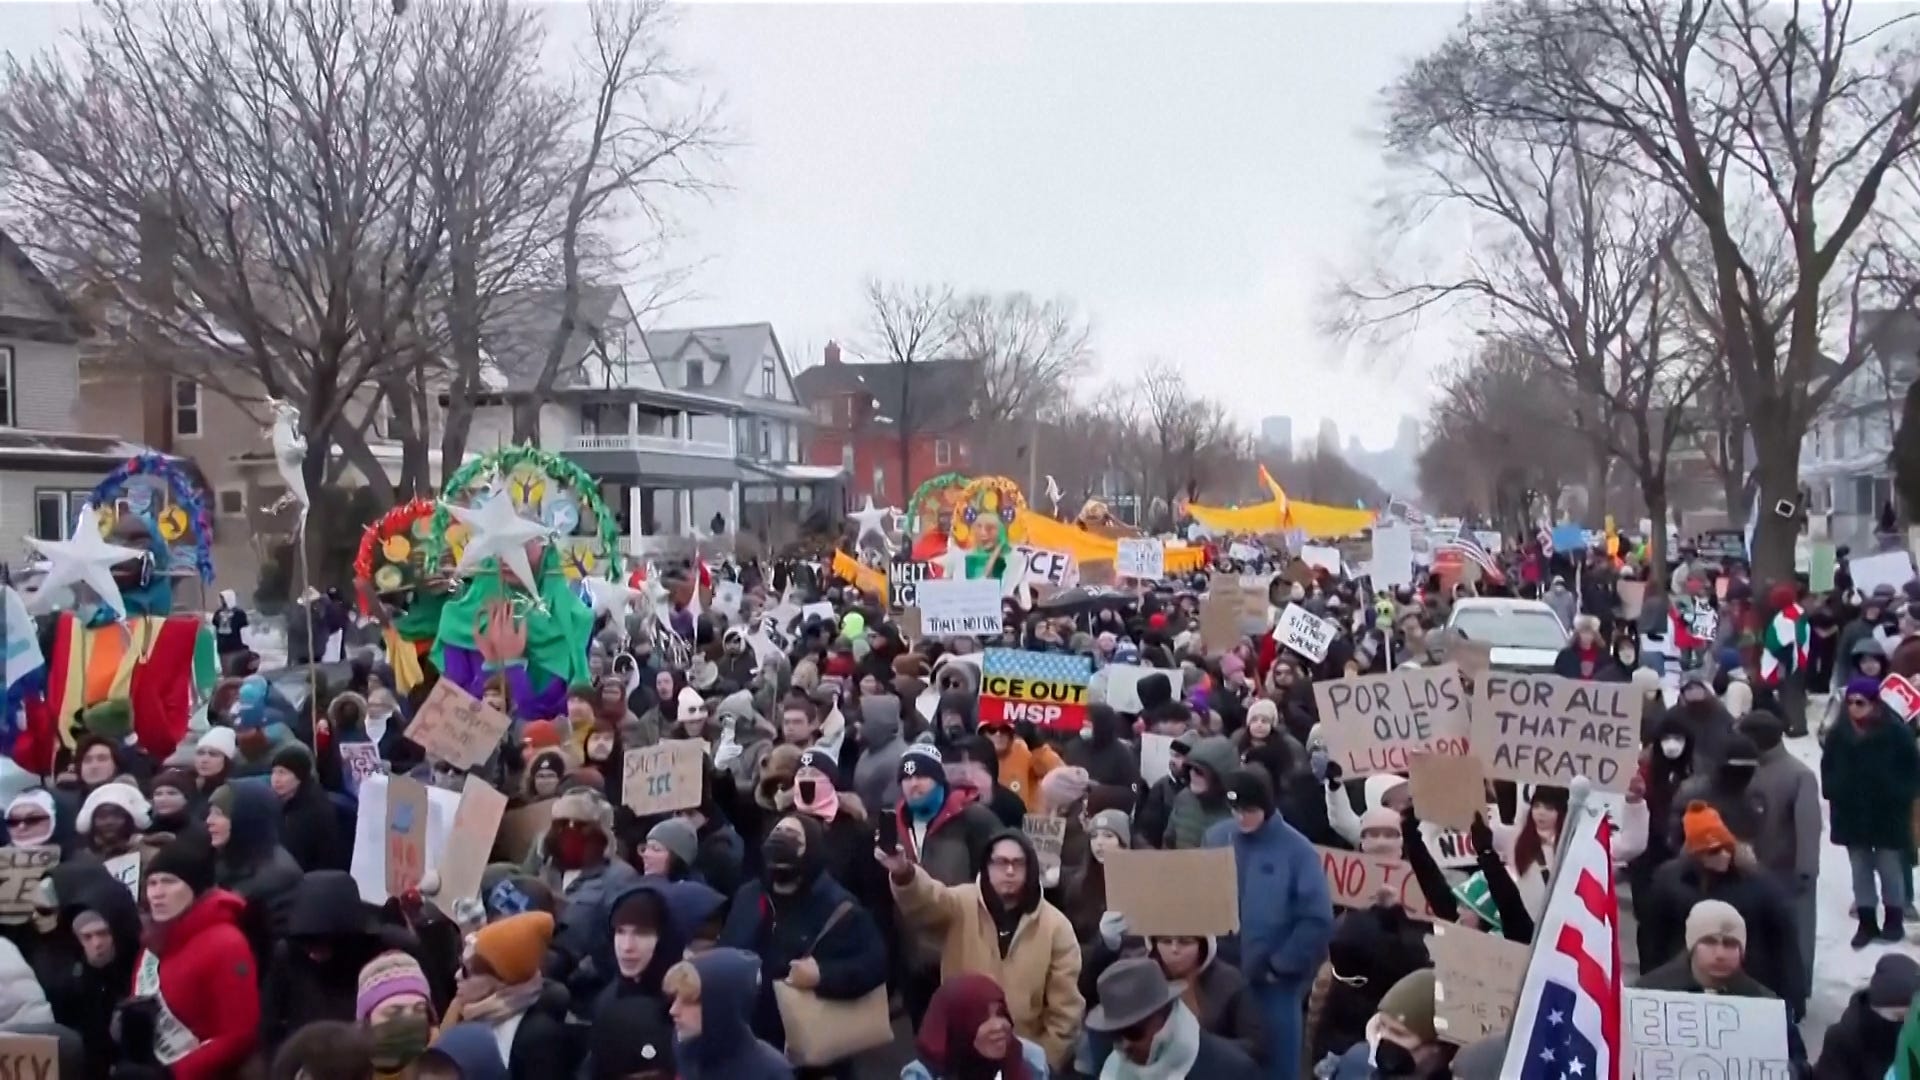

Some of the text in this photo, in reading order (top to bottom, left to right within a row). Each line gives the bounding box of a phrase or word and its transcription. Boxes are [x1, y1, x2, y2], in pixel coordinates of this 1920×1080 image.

[891, 563, 927, 584] MELT
[983, 615, 999, 630] OK
[982, 677, 1087, 702] ICE OUT
[1328, 678, 1460, 721] POR LOS
[1487, 678, 1628, 718] FOR ALL
[1003, 701, 1062, 724] MSP
[1374, 711, 1432, 741] QUE
[1495, 711, 1632, 748] THAT ARE
[1324, 852, 1366, 897] NO
